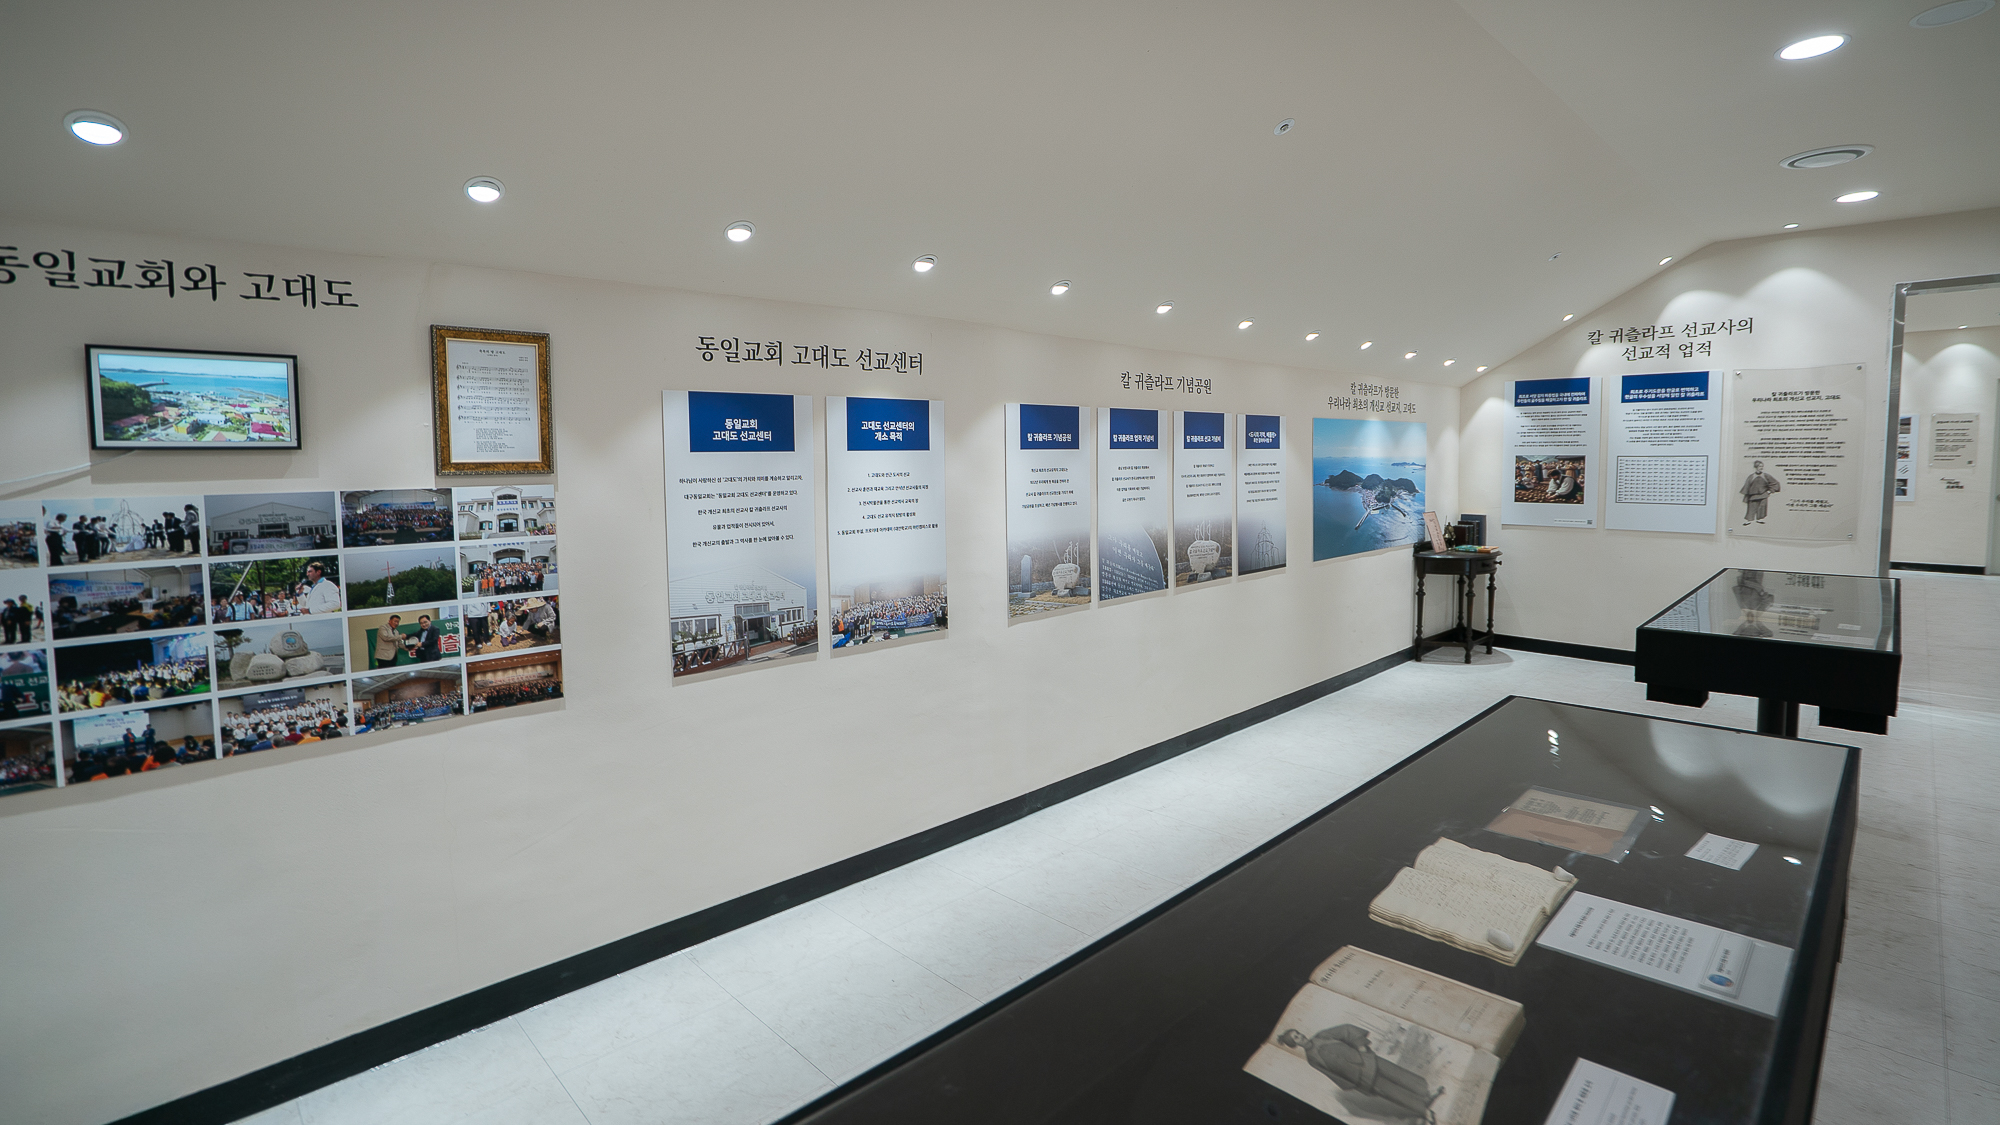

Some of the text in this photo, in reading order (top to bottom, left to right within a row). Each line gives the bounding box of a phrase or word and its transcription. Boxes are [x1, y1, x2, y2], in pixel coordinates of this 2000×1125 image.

[0, 246, 360, 309] 동일교회와 고대도
[1588, 317, 1754, 346] 칼 귀츨라프 선교사의
[695, 335, 924, 376] 동일교회 고대도 선교센터
[1621, 340, 1712, 362] 선교적 업적
[1120, 371, 1213, 395] 칼 귀츨라프 기념공원
[1350, 381, 1400, 399] 칼 귀츨라프가 방문한
[1328, 396, 1351, 410] 우리나라
[1352, 398, 1368, 411] 최초의
[1369, 400, 1384, 412] 개신교
[1402, 402, 1416, 414] 고대도
[724, 419, 758, 430] 동일교회
[861, 421, 915, 431] 고대도 선교센터의
[712, 430, 772, 441] 고대도 선교센터
[874, 432, 903, 441] 개소 목적
[1027, 433, 1072, 442] 칼 귀츨라프 기념공원
[705, 591, 740, 604] 동일교회
